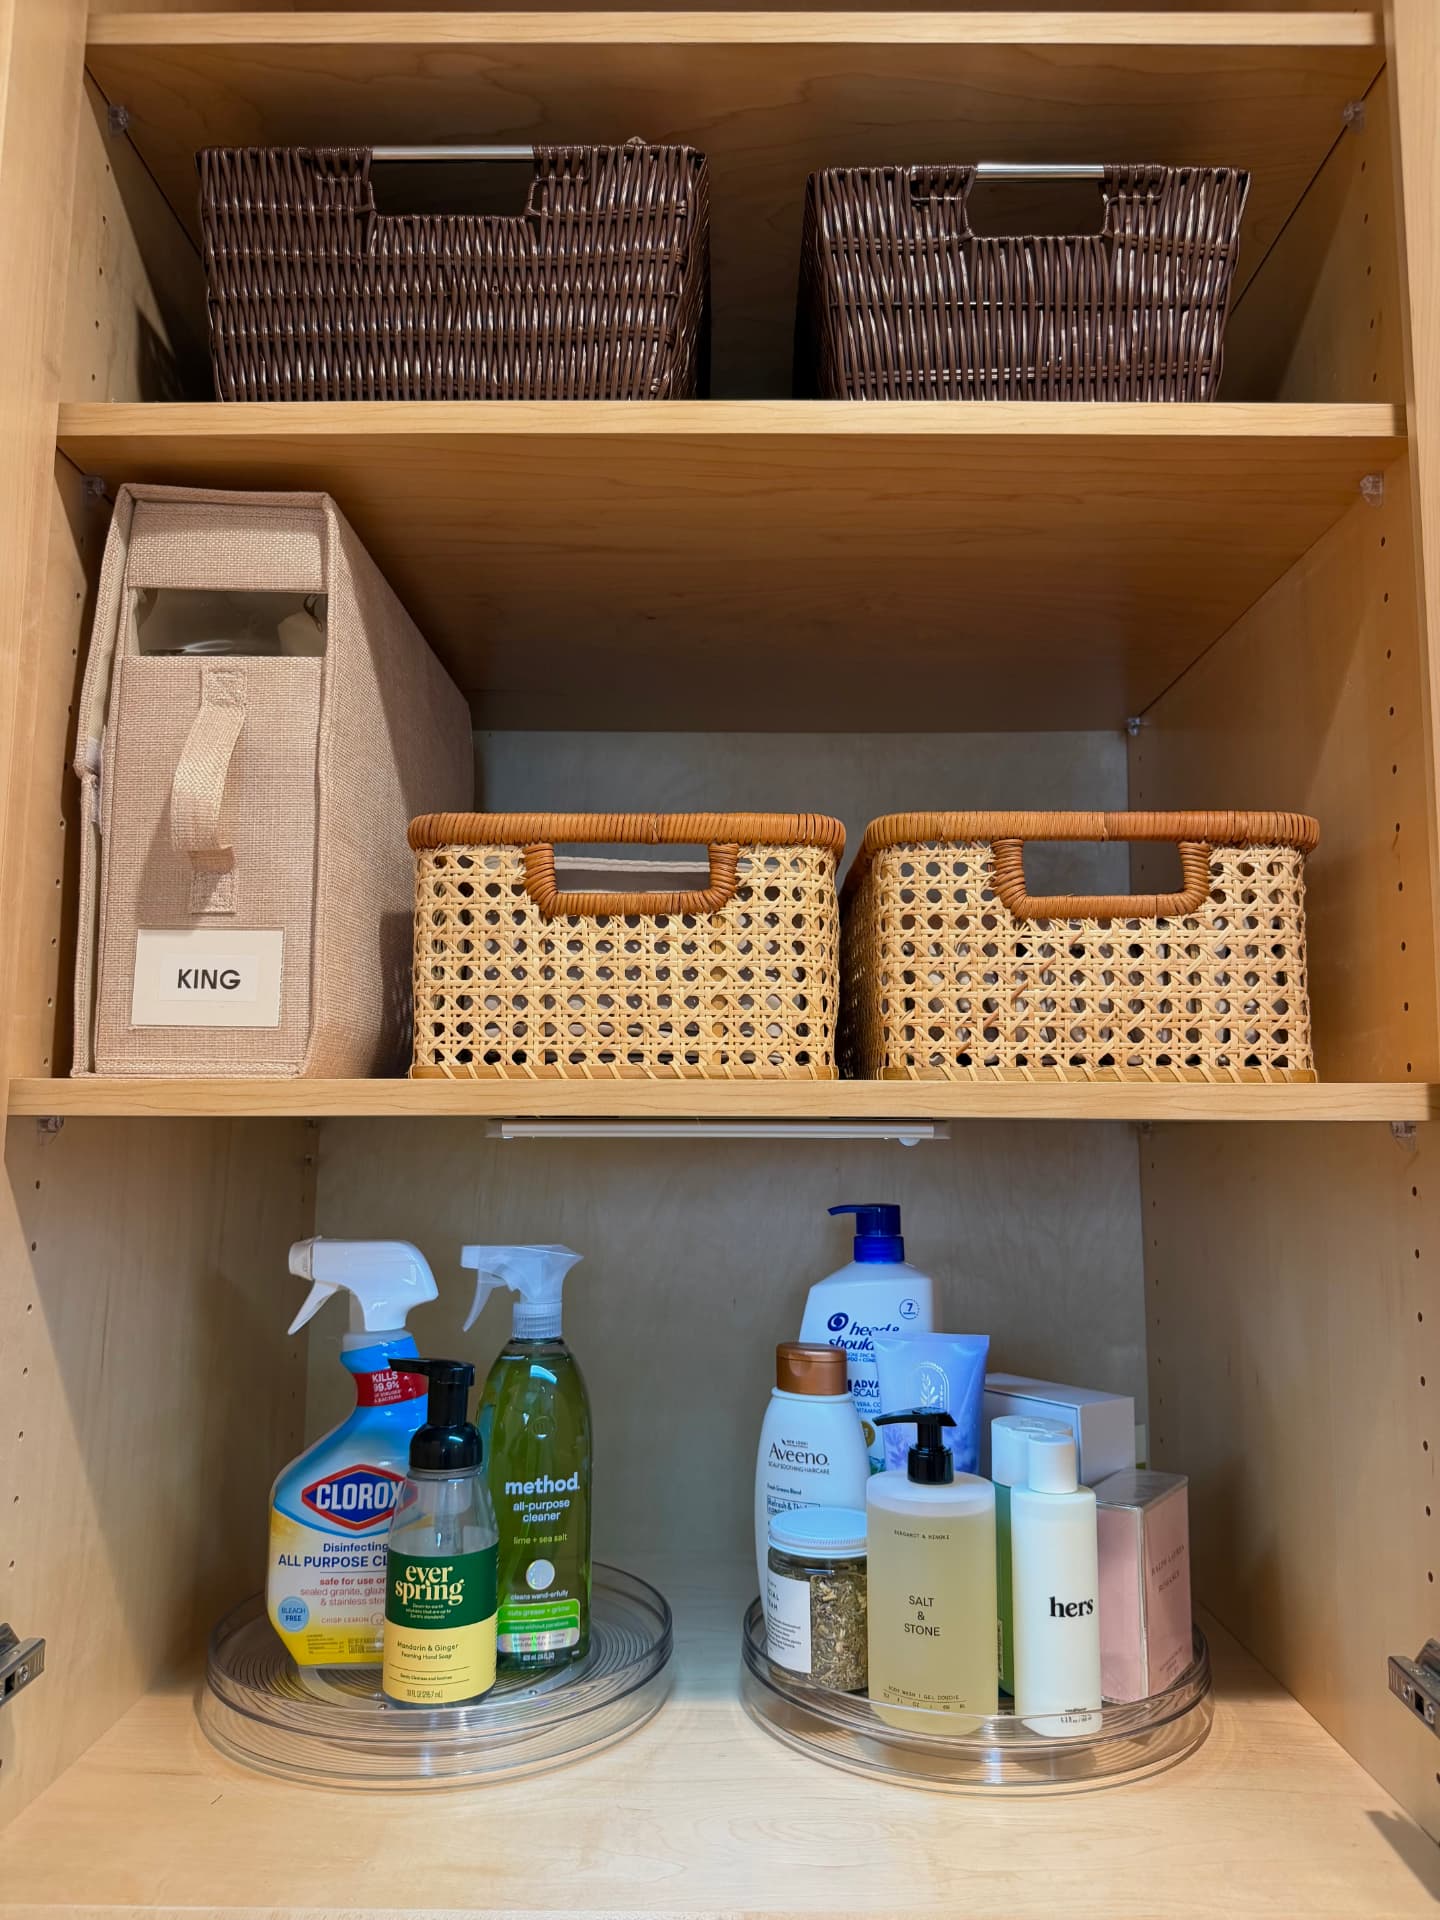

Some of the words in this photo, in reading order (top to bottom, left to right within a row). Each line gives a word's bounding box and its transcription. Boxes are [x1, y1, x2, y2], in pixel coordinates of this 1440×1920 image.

[177, 968, 241, 990] KING
[907, 1303, 913, 1311] 7
[372, 1371, 398, 1382] KILLS
[373, 1380, 399, 1392] 99.9%
[769, 1441, 828, 1466] Aveeno
[505, 1472, 579, 1495] method
[316, 1480, 405, 1510] CLOROX
[513, 1499, 570, 1512] all-purpose
[523, 1512, 561, 1522] cleaner
[513, 1536, 531, 1545] lime
[539, 1536, 553, 1544] sea
[554, 1533, 568, 1542] salt
[323, 1542, 389, 1552] Disinfecting
[278, 1554, 302, 1567] ALL
[304, 1555, 369, 1568] PURPOSE
[405, 1565, 454, 1584] ever
[320, 1577, 340, 1586] safe
[341, 1576, 355, 1585] for
[357, 1576, 374, 1585] use
[300, 1587, 328, 1596] sealed
[395, 1578, 465, 1606] spring
[330, 1597, 367, 1607] stainless
[908, 1594, 935, 1608] SALT
[1049, 1596, 1093, 1617] hers
[281, 1606, 306, 1615] BLEACH
[917, 1611, 925, 1621] &
[285, 1614, 303, 1622] FREE
[904, 1622, 942, 1637] STONE
[397, 1640, 427, 1652] Mandarin
[427, 1644, 433, 1652] &
[434, 1643, 459, 1652] Ginger
